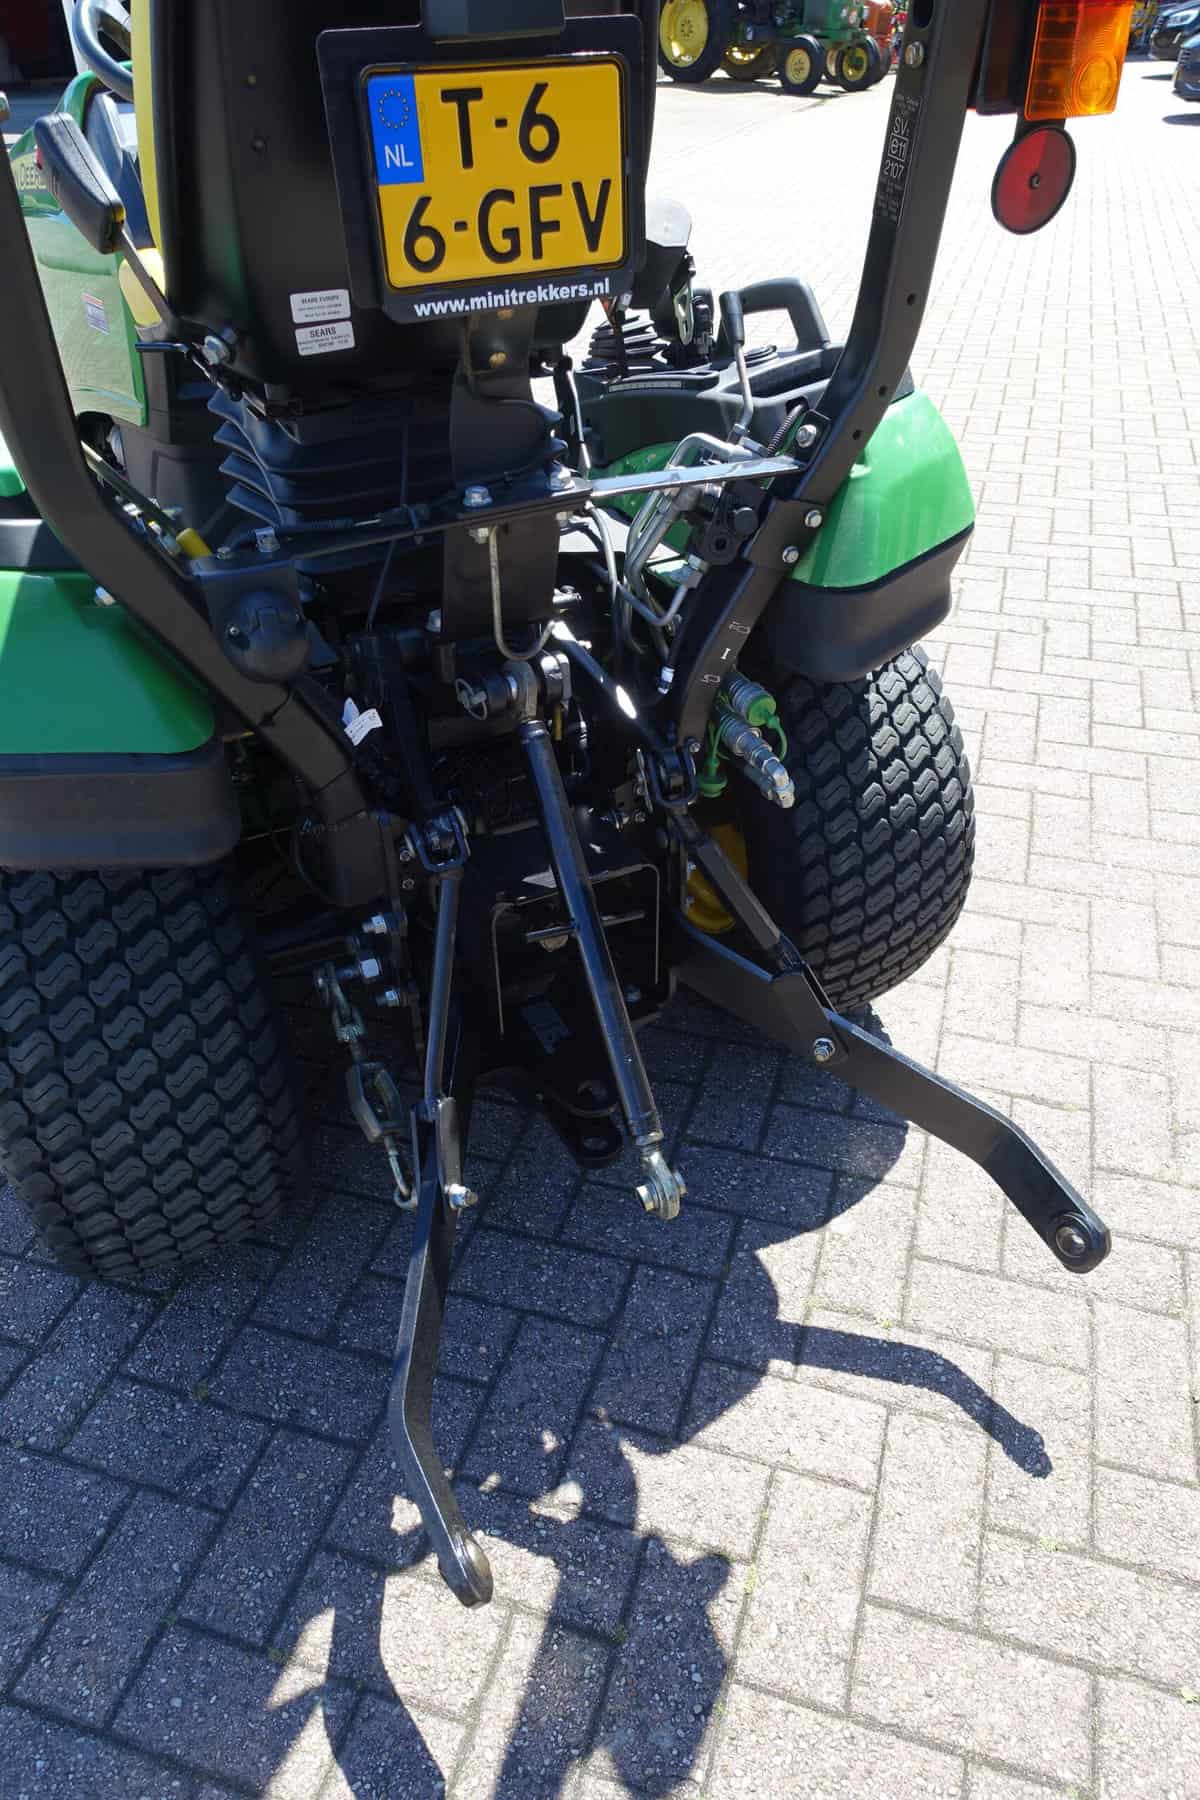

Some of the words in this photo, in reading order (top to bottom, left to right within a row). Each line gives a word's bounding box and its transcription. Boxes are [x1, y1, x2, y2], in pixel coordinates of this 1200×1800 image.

[440, 82, 560, 170] T-6
[384, 144, 414, 169] NL
[883, 159, 905, 178] 2107
[403, 178, 612, 274] 6-GFV
[414, 277, 610, 318] www.minitrekkers.nl
[310, 326, 337, 338] SEARS
